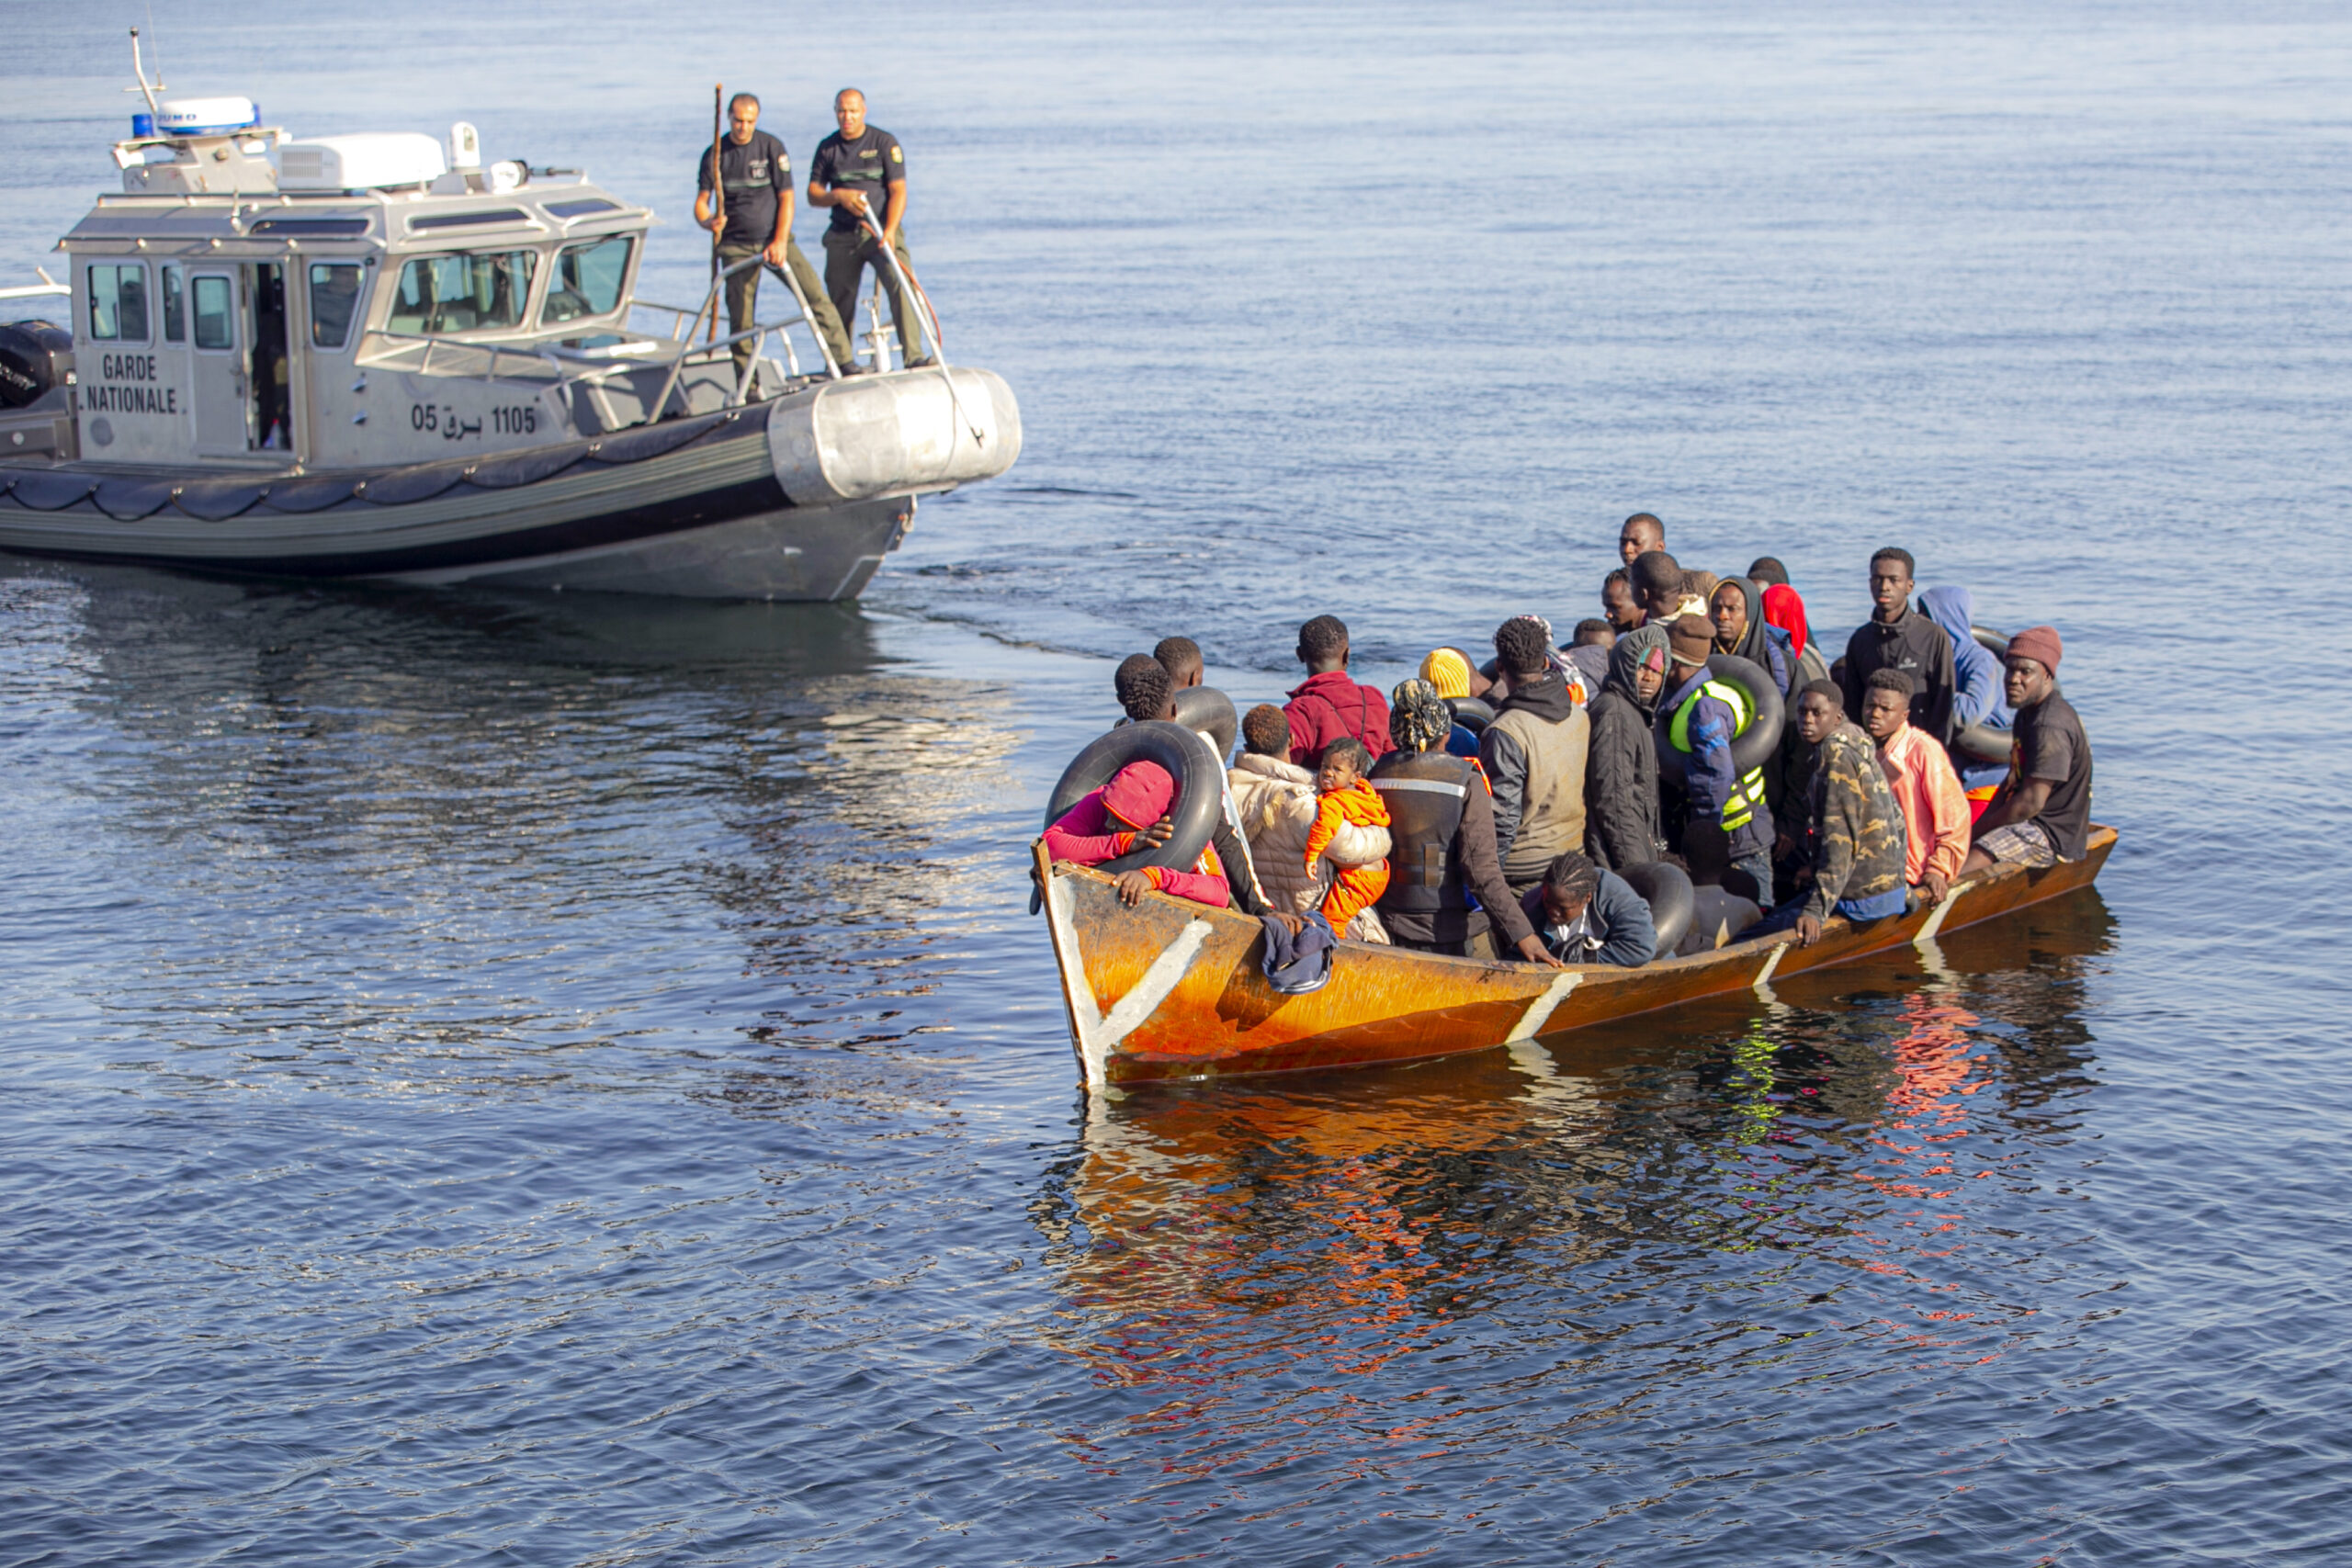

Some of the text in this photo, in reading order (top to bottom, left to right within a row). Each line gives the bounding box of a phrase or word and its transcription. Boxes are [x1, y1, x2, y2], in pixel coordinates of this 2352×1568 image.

[103, 354, 156, 381] GARDE
[87, 385, 176, 414] NATIONALE
[412, 404, 437, 431] 05
[492, 406, 537, 434] 1105
